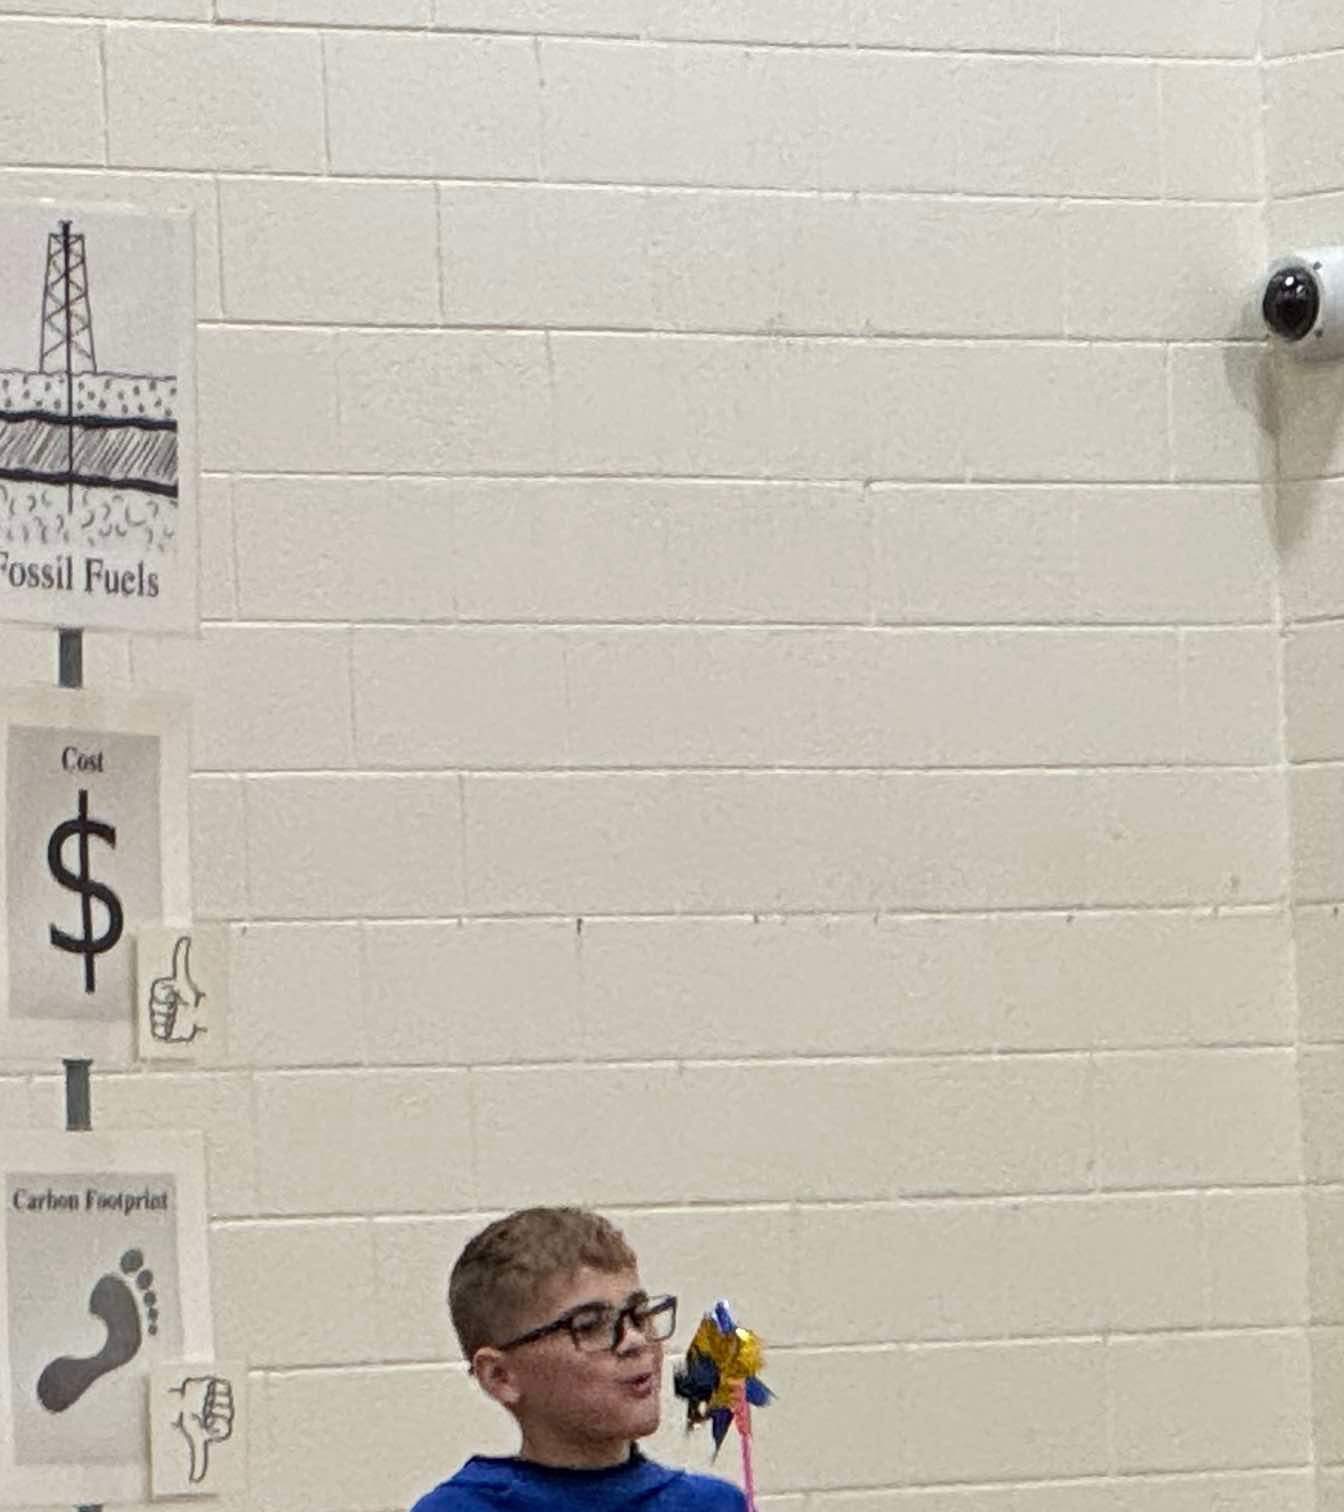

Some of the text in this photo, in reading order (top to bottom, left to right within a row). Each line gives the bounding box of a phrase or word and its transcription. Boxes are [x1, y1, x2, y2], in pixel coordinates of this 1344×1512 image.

[84, 557, 160, 598] Fuels
[62, 746, 105, 773] Cost
[48, 788, 124, 994] $
[13, 1186, 168, 1216] Carbon Footprint
